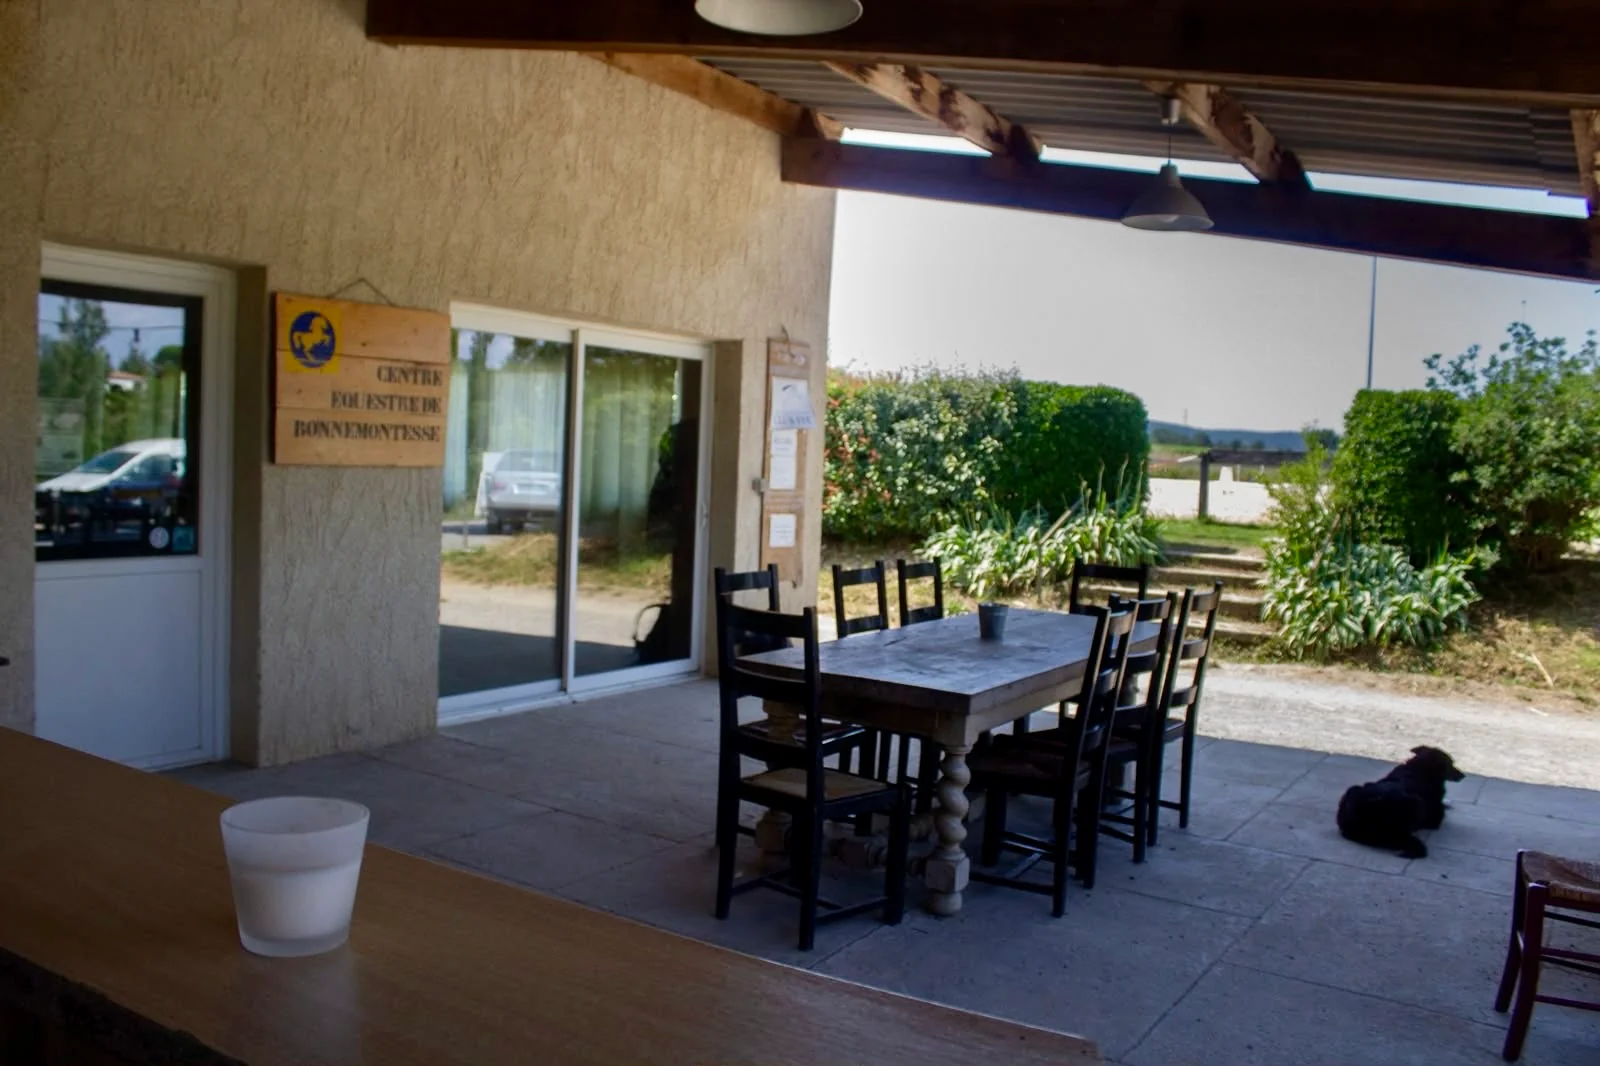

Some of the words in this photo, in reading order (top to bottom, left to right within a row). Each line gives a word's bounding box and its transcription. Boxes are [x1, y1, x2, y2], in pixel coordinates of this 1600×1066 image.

[377, 365, 443, 386] CENTRE
[331, 391, 419, 412] EQUESTRE
[422, 396, 441, 413] DE
[294, 420, 440, 441] BONNEMONTESSE
